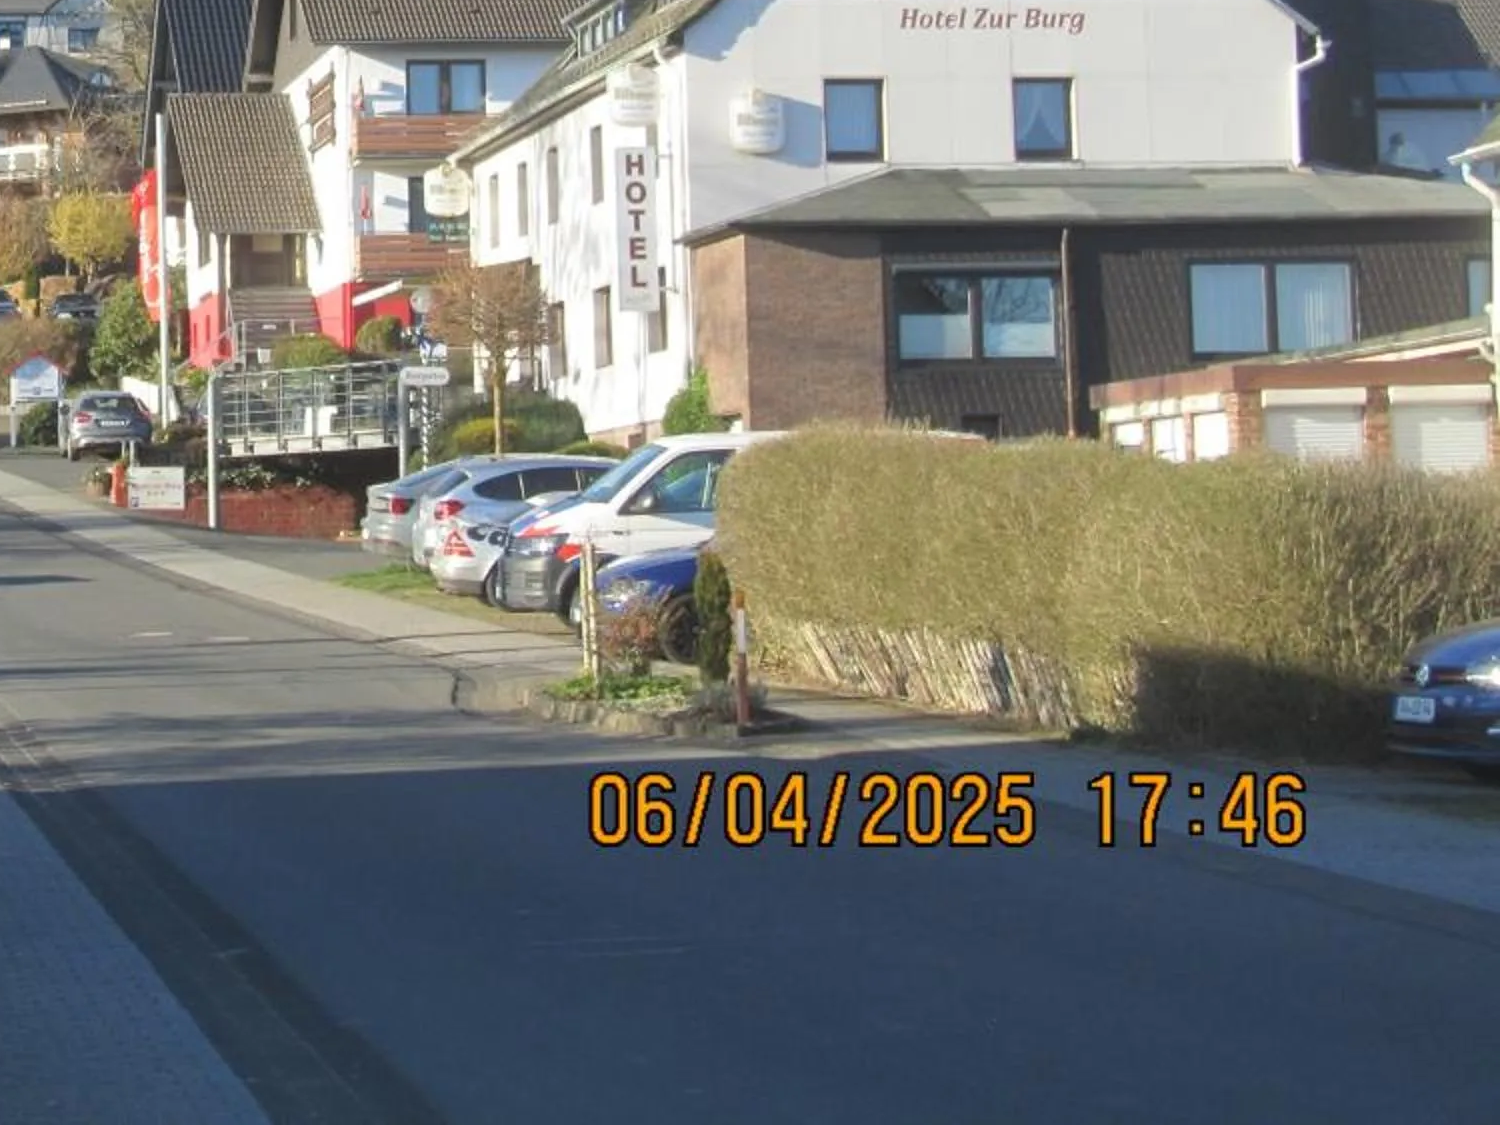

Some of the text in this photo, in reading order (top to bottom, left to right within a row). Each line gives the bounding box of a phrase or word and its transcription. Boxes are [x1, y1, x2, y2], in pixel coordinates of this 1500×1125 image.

[900, 7, 1086, 36] Hotel Zur Burg
[625, 153, 648, 288] HOTEL
